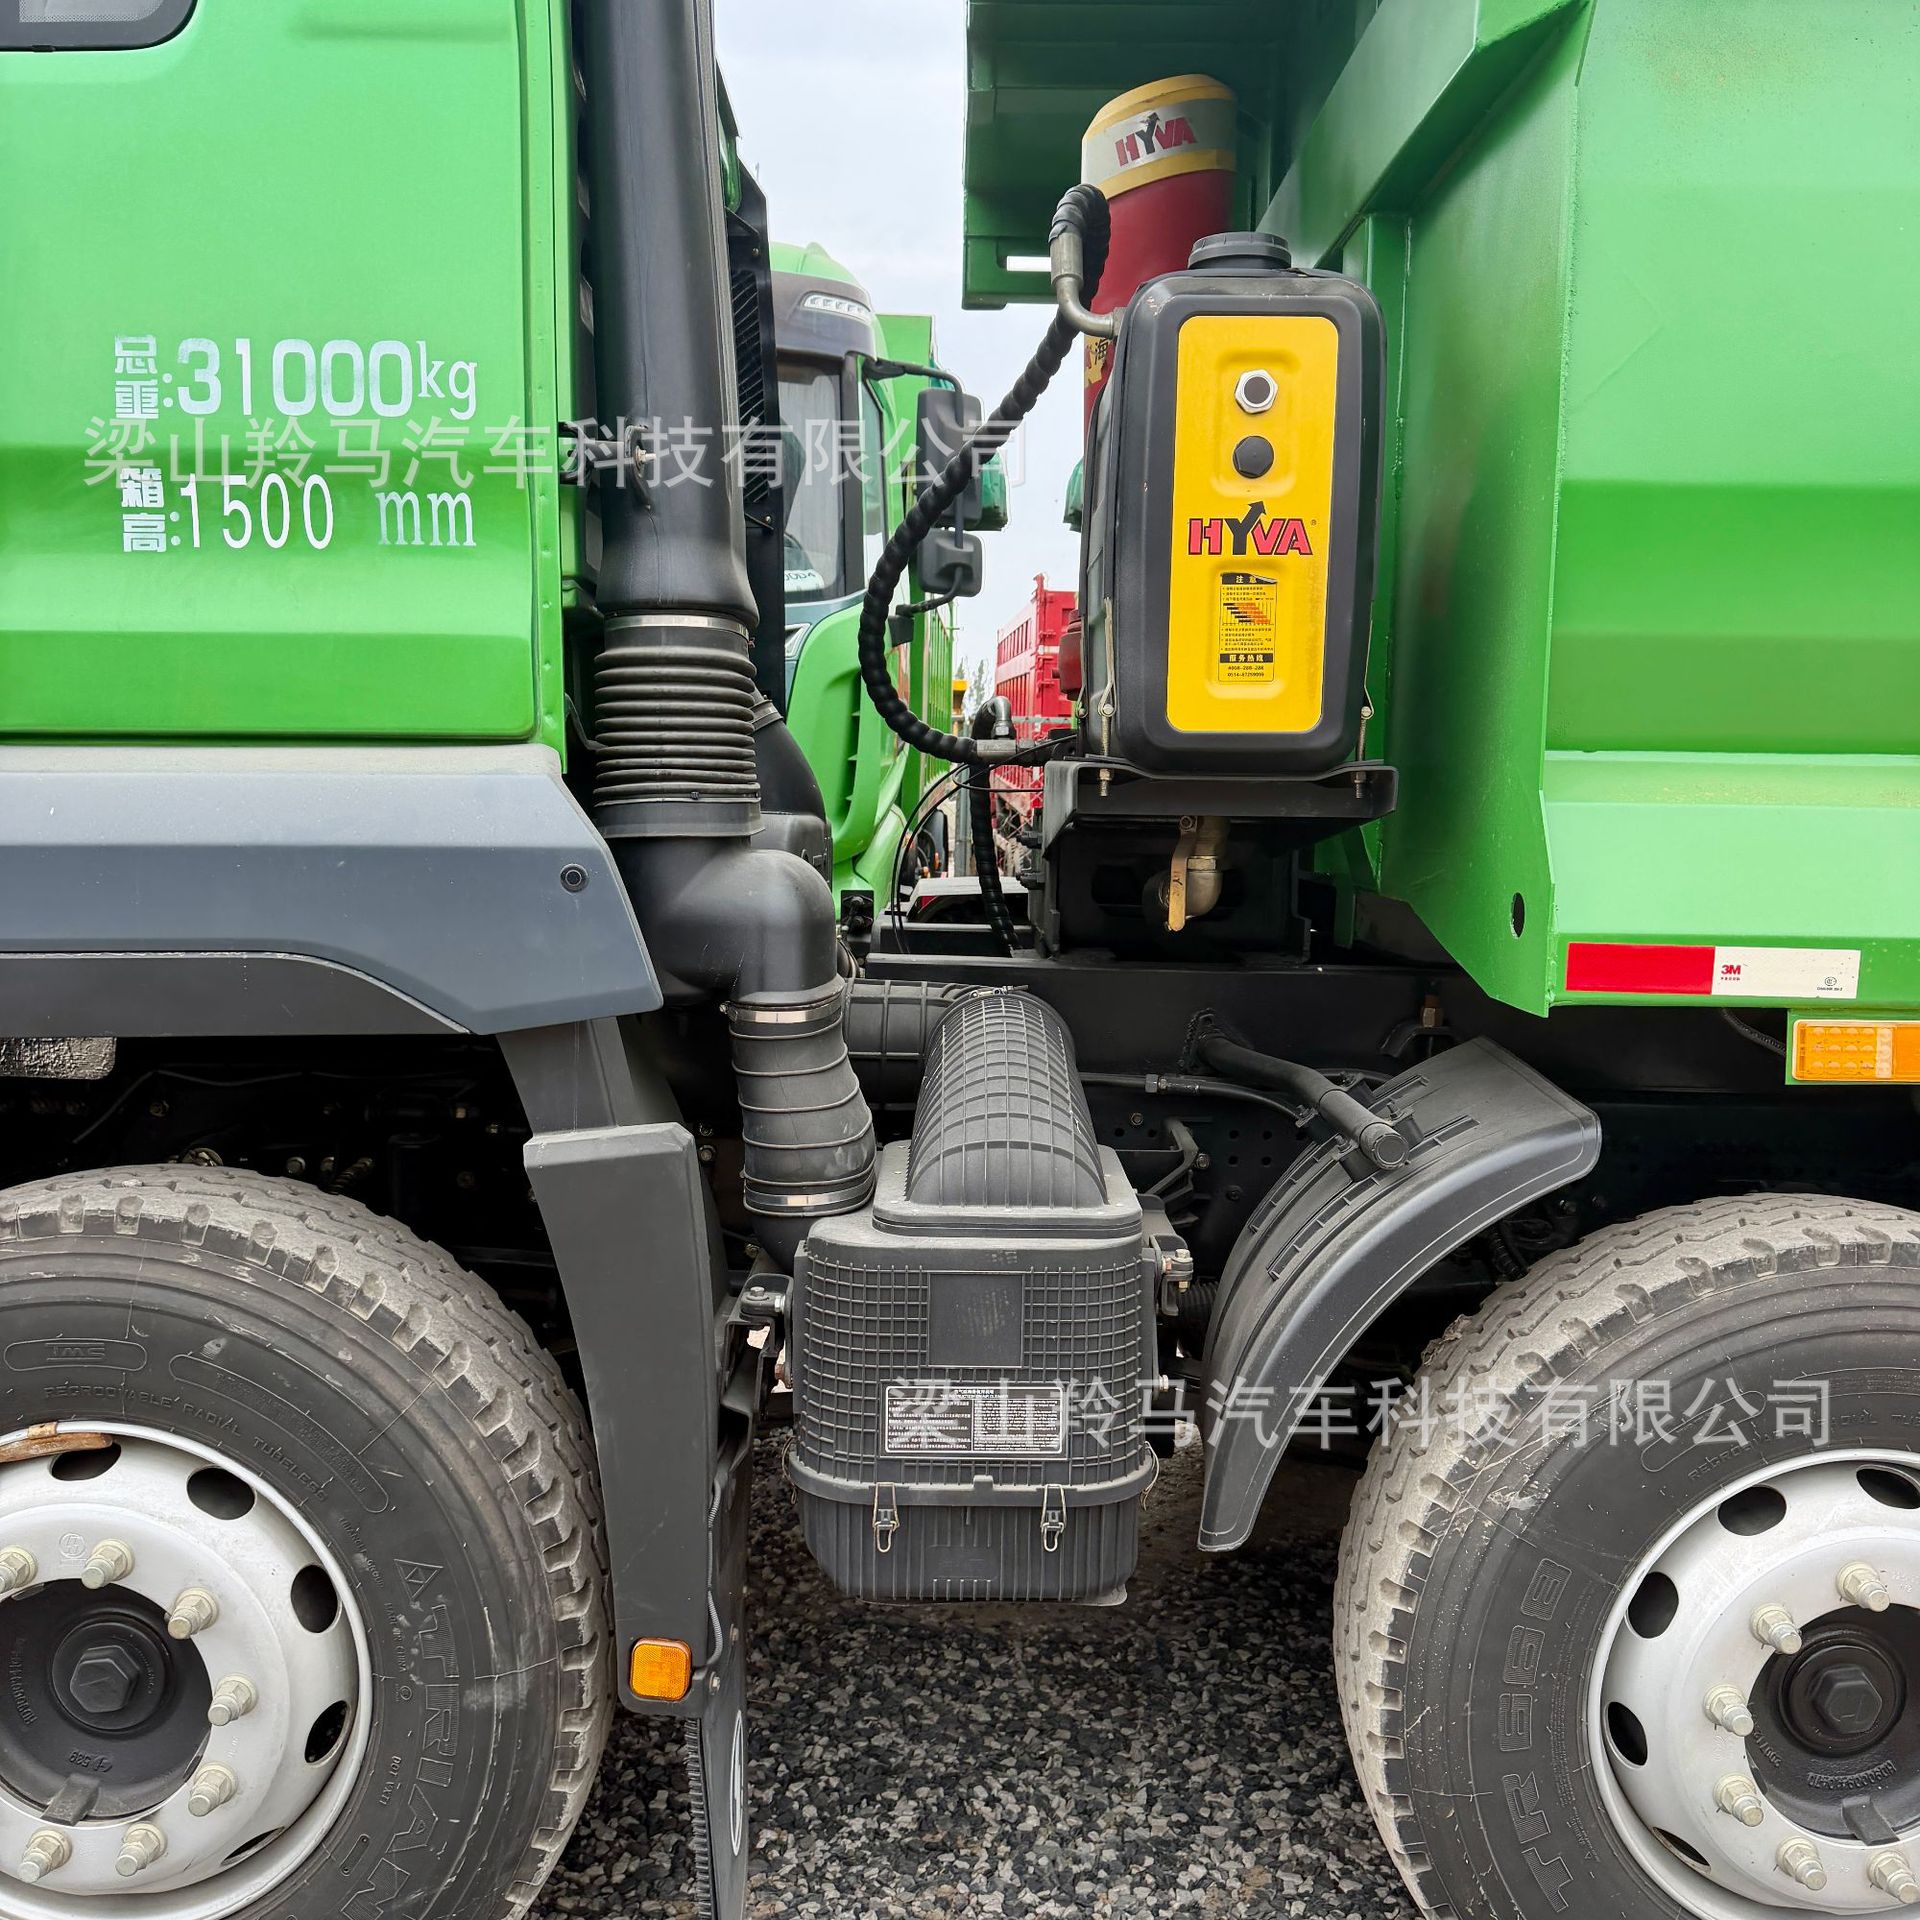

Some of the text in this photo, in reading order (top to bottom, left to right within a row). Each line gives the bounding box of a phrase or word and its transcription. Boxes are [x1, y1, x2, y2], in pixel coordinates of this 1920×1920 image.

[1115, 112, 1198, 167] HYVA
[377, 489, 477, 548] mm
[1187, 500, 1314, 556] HYVA
[1721, 964, 1742, 976] 3M
